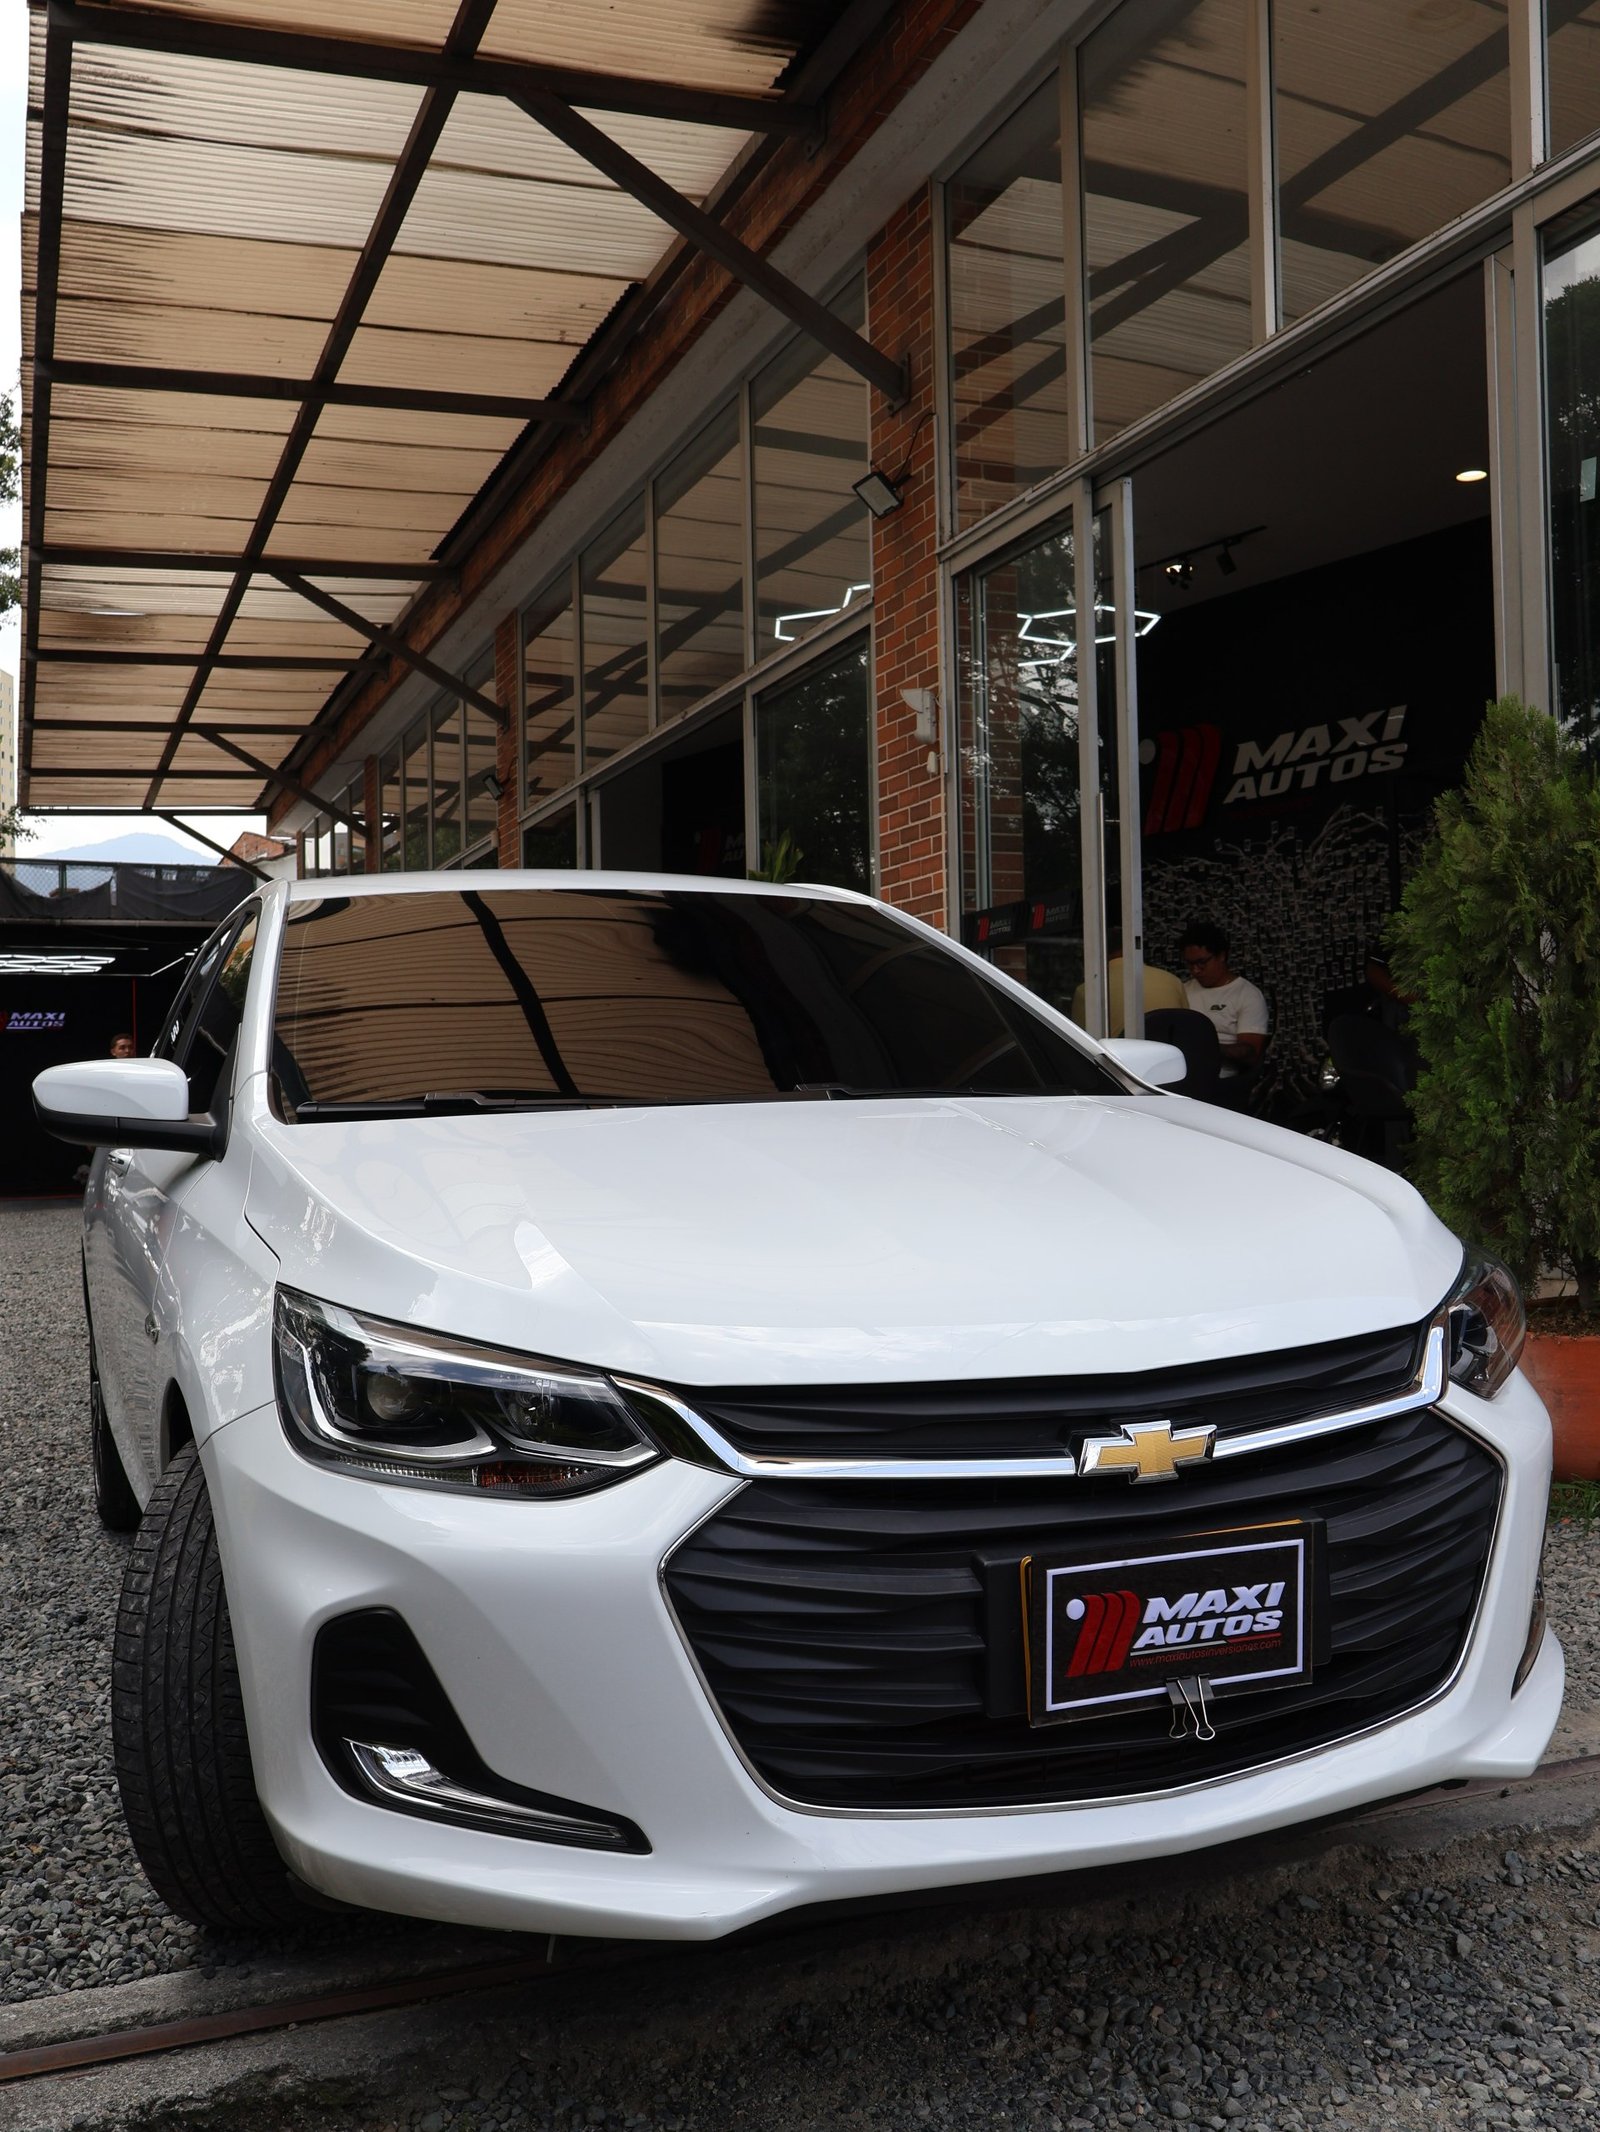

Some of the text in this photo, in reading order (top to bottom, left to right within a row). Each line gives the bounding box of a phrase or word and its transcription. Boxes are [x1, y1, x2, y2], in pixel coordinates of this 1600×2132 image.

[1232, 704, 1408, 775] MAXI
[1222, 742, 1408, 805] AUTOS
[10, 1012, 66, 1020] MAXI
[1142, 1582, 1286, 1624] MAXI
[1132, 1609, 1284, 1649] AUTOS
